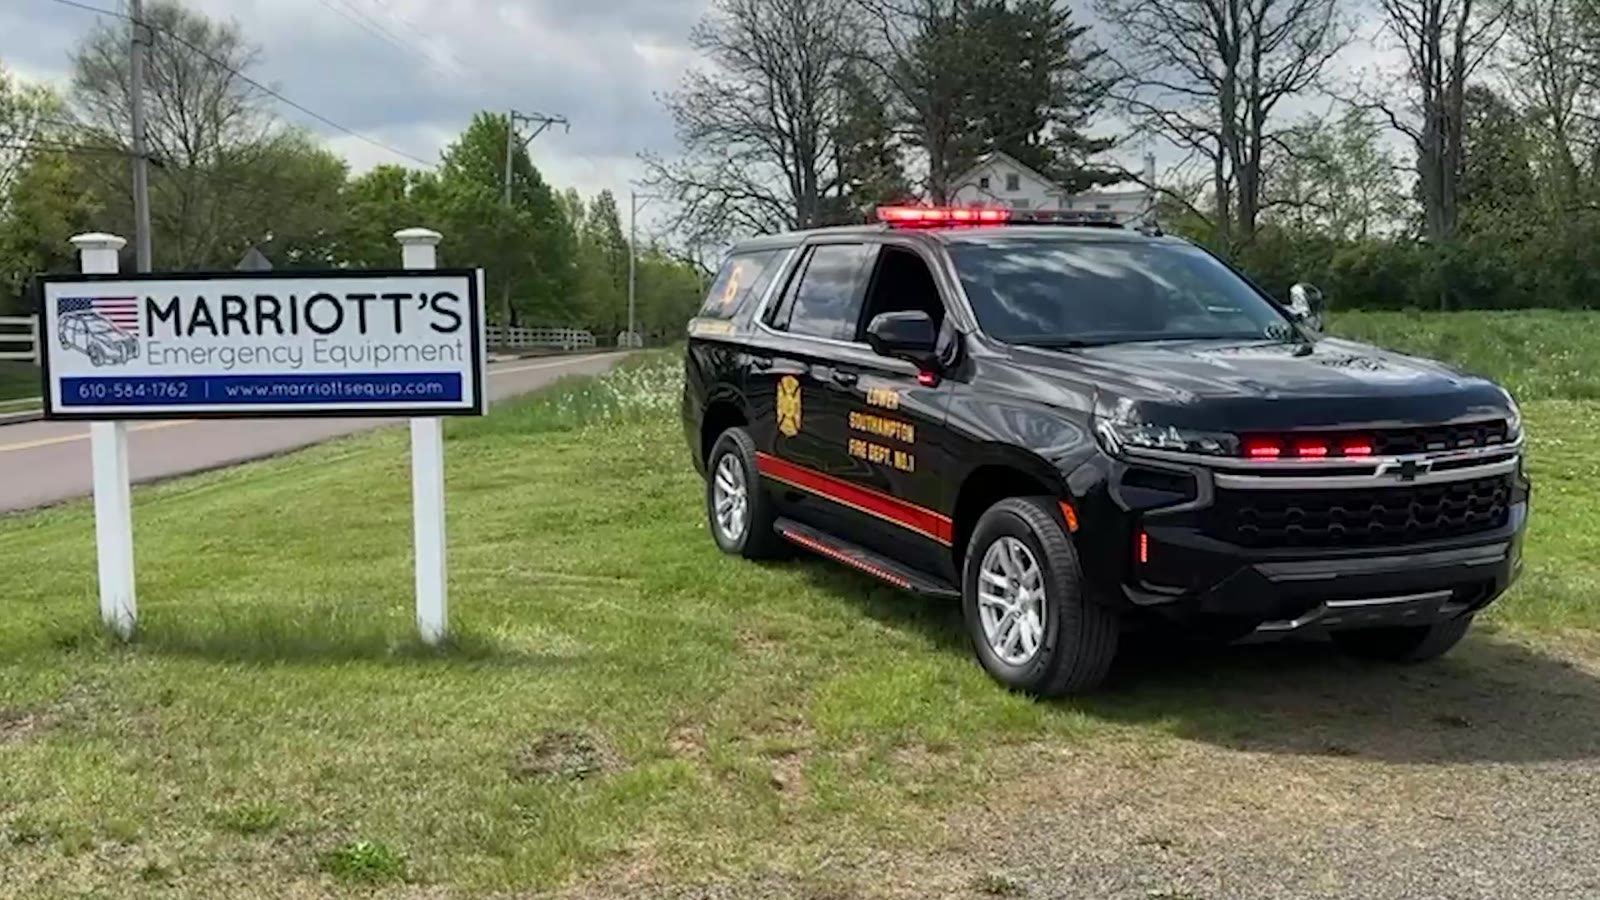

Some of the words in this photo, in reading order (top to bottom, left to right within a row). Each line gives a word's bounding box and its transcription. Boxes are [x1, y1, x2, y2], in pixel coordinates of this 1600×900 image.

[145, 291, 463, 337] MARRIOTT'S
[147, 340, 303, 371] Emergency
[314, 337, 464, 364] Equipment
[79, 381, 189, 399] 610-584-1762
[225, 380, 444, 398] www.marriottsequip.com
[866, 387, 899, 410] LOWER
[849, 411, 914, 443] SOUTHAMPTON
[849, 438, 867, 459] FIRE
[868, 442, 893, 467] DEPT.
